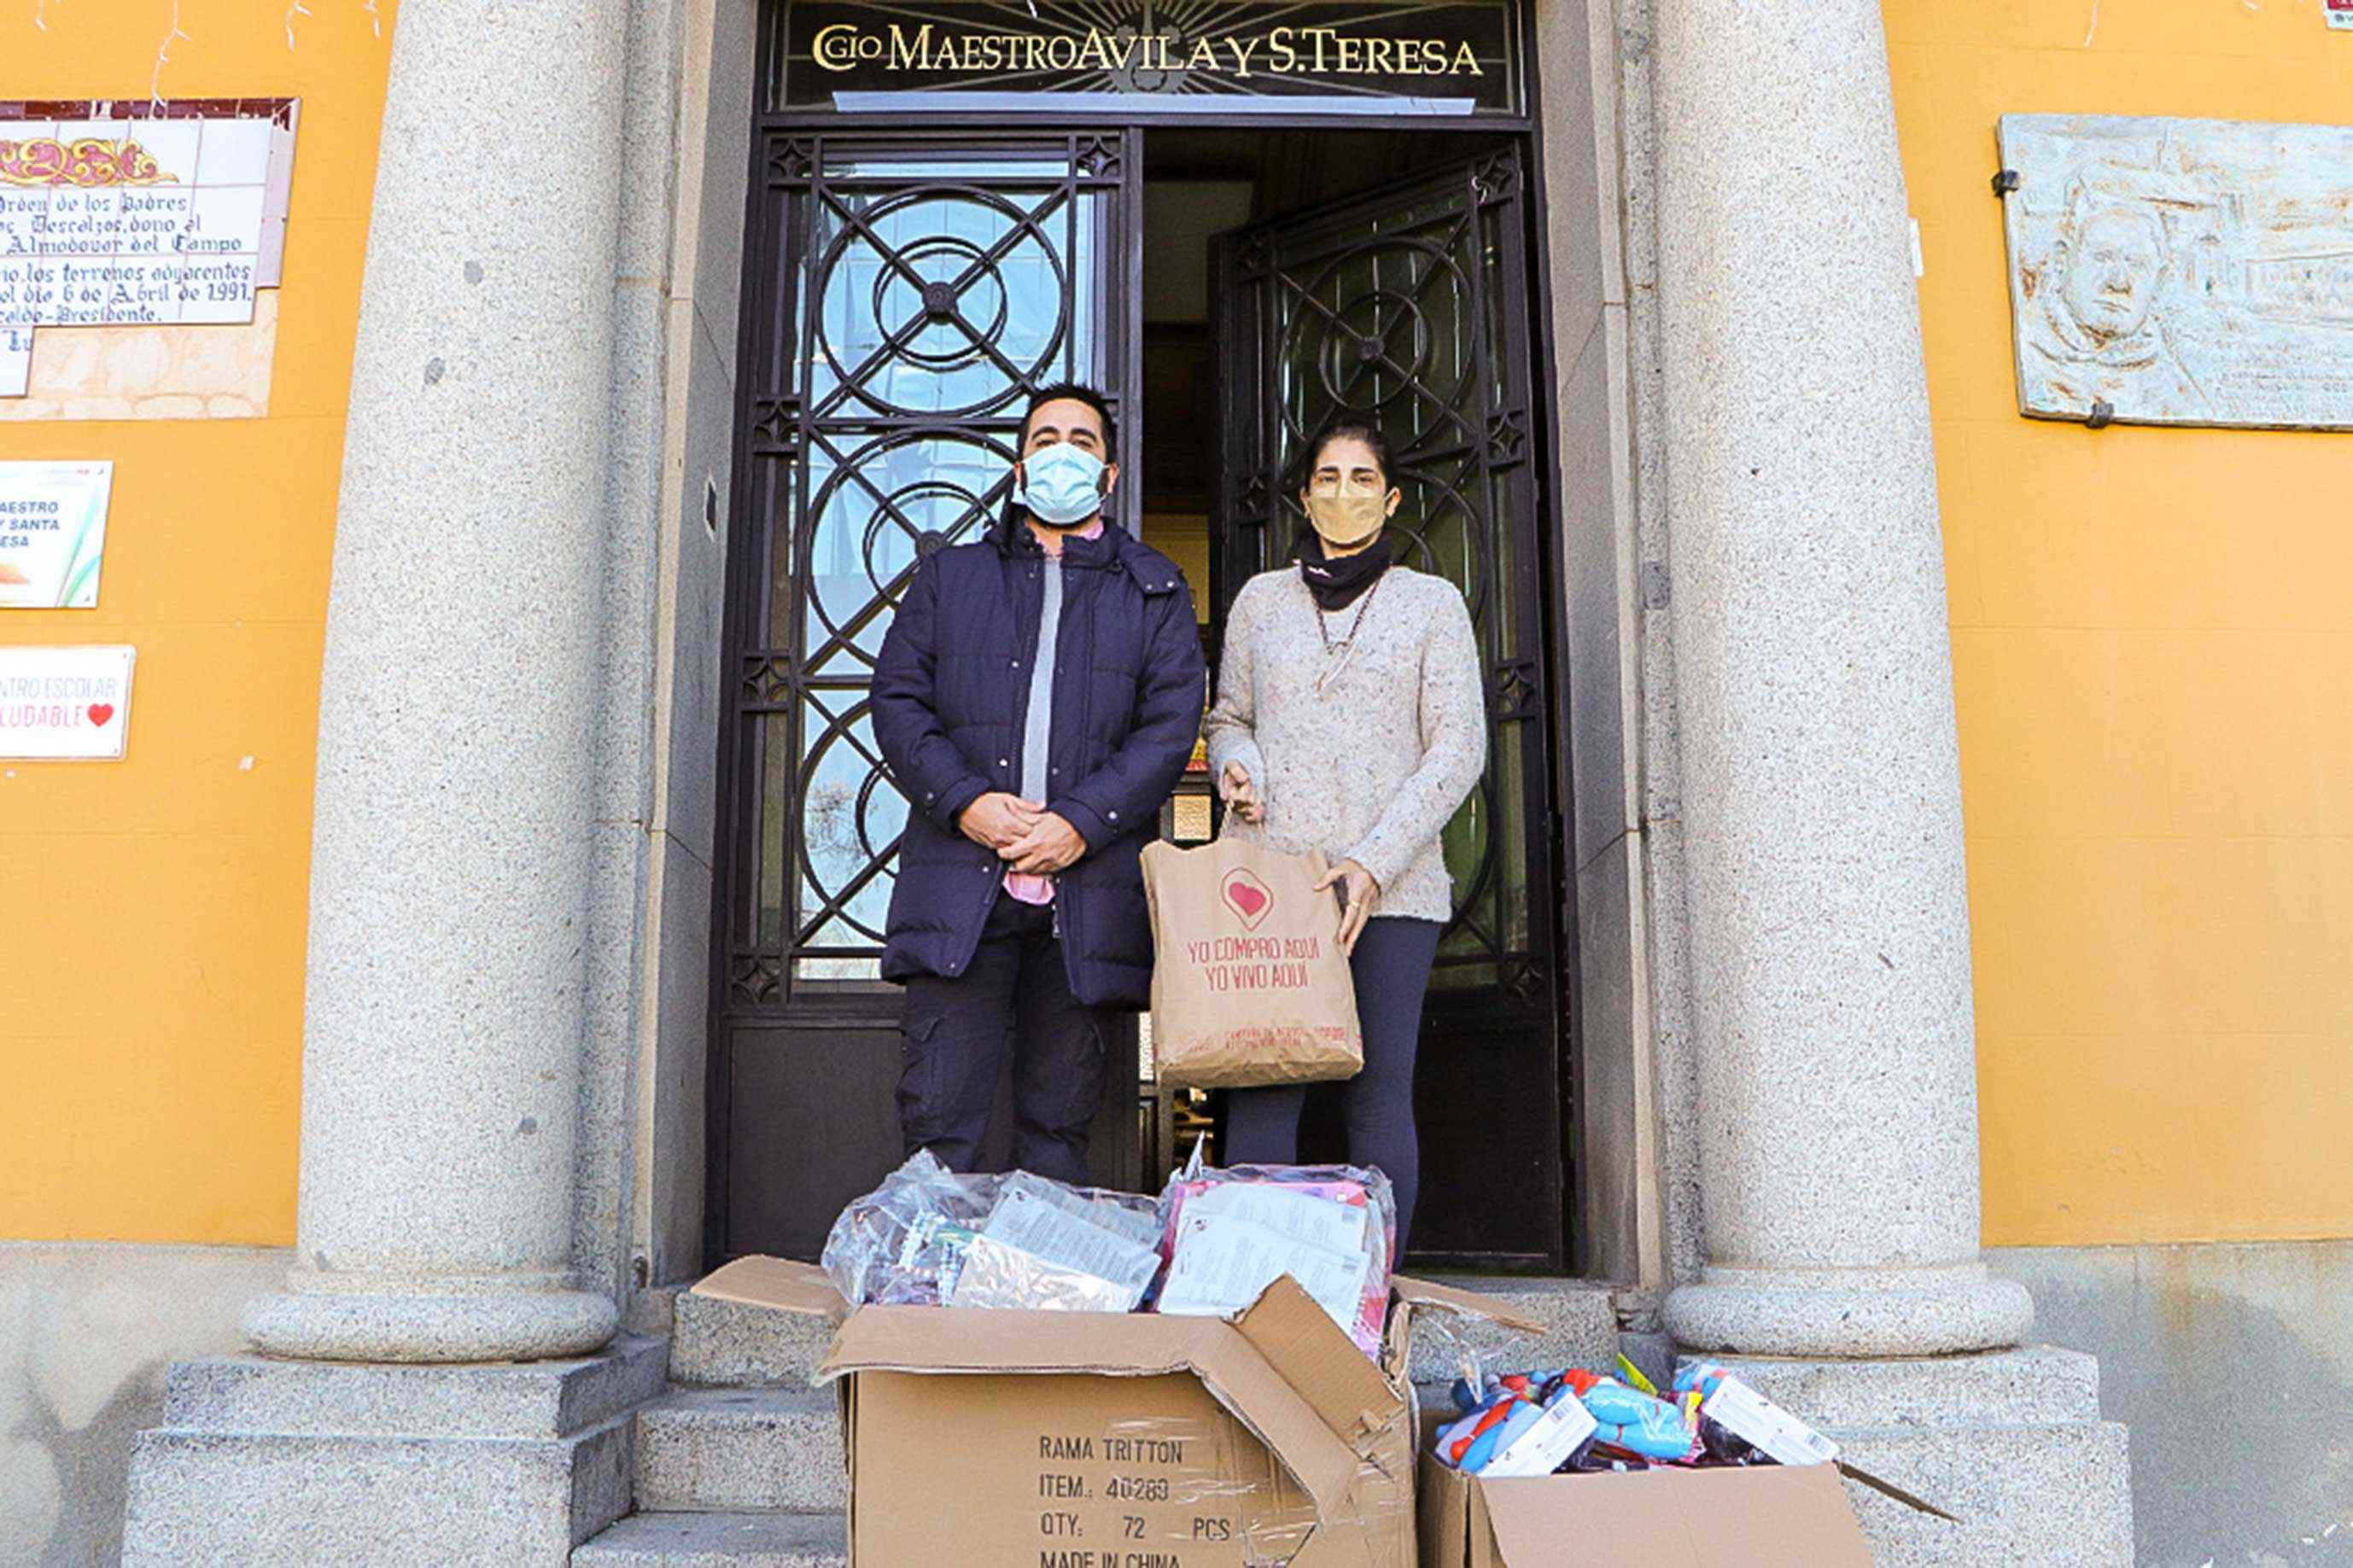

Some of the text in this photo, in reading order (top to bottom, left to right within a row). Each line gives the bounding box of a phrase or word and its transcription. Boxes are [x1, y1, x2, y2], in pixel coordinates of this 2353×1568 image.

[885, 24, 1077, 70] MAESTRO
[1073, 26, 1221, 70] AVILA
[1224, 35, 1259, 77] Y
[56, 194, 79, 212] de
[85, 193, 110, 212] los
[130, 233, 160, 253] del
[63, 263, 145, 283] terrenos
[80, 286, 102, 303] de
[178, 284, 201, 301] de
[9, 519, 60, 531] SANTA
[1188, 941, 1210, 963] YO
[1215, 937, 1281, 961] COMPRO
[1206, 965, 1228, 990] YO
[1231, 965, 1268, 989] VIVO
[1039, 1435, 1182, 1464] RAMA TRITTON
[1123, 1516, 1145, 1539] 72
[1193, 1517, 1229, 1542] PCS
[1040, 1550, 1180, 1568] MADE IN CHINA
